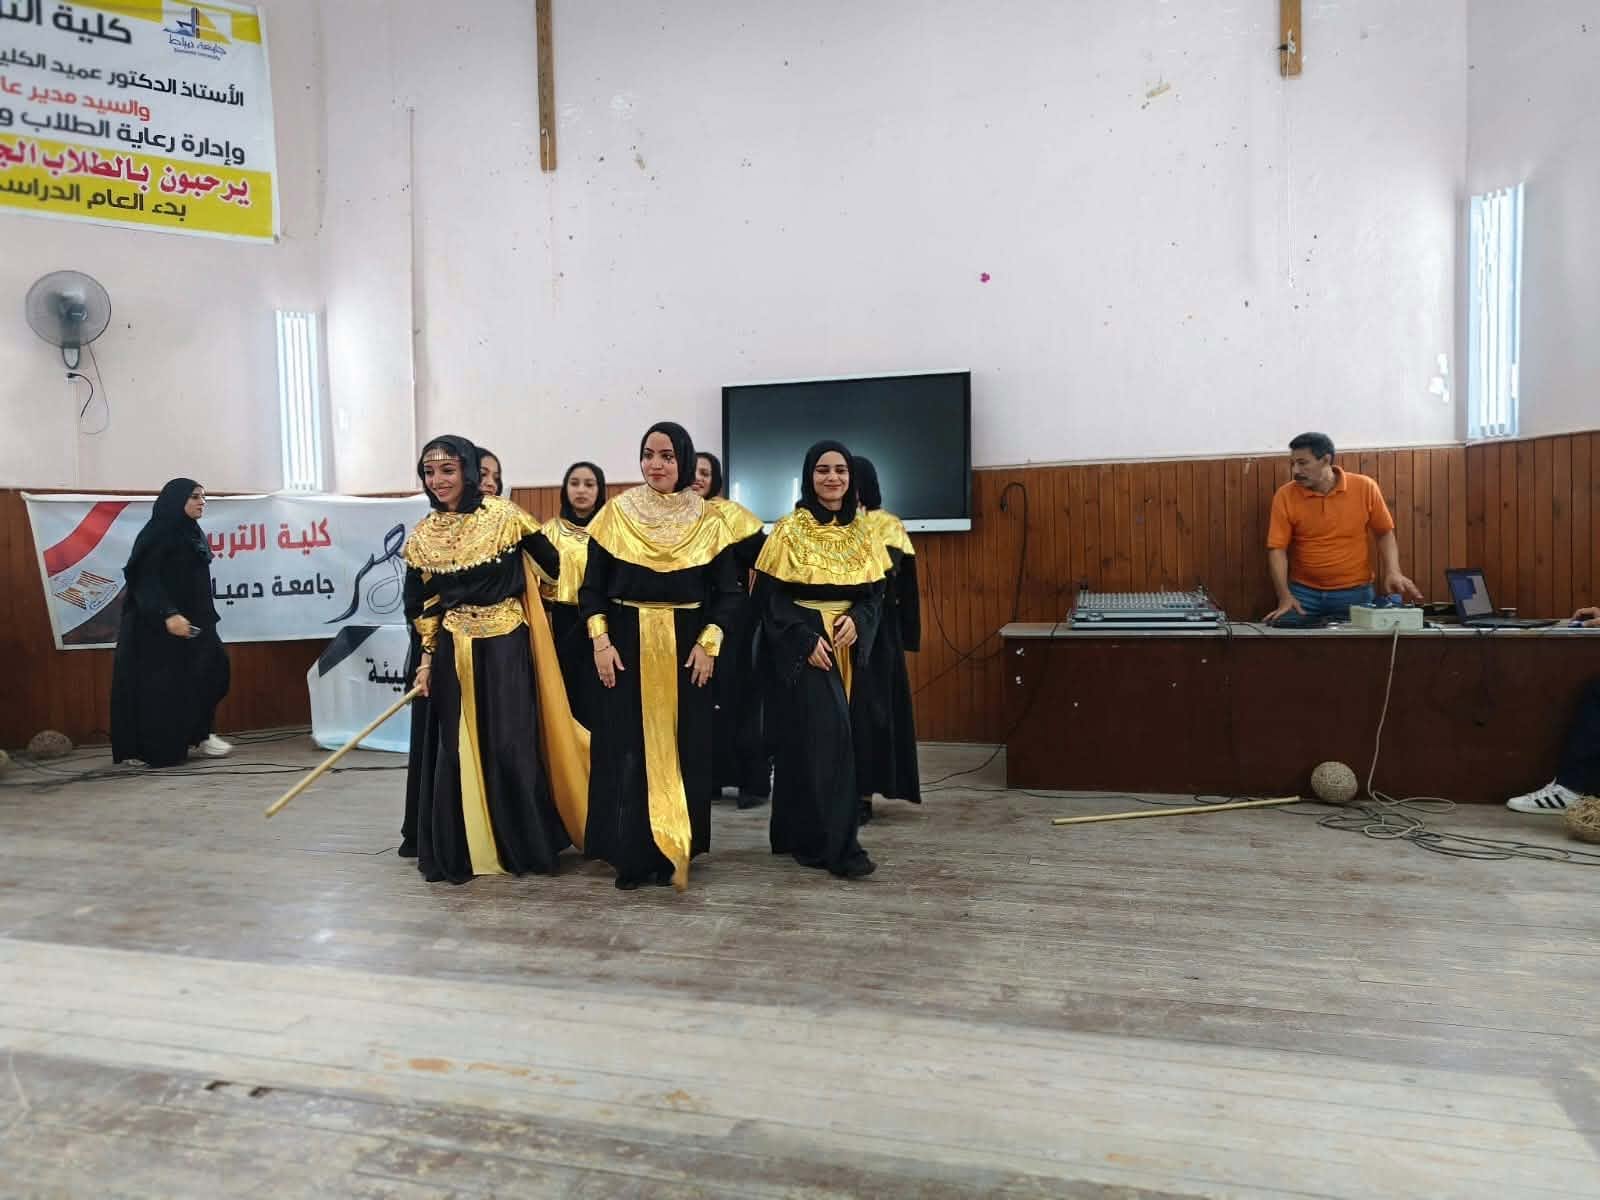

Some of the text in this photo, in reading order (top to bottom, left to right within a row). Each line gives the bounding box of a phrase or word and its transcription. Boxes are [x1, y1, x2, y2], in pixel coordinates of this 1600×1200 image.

[52, 5, 132, 44] كلية
[0, 48, 244, 107] الأستاذ الدكتور عميد الكلي
[0, 75, 151, 122] والسيد مدير عا
[21, 112, 110, 138] الطلاب
[116, 122, 176, 150] رعاية
[180, 134, 245, 165] وإدارة
[0, 141, 250, 205] يرحبون بالطلاب الج
[0, 178, 187, 221] بدء العام الدراس
[207, 517, 332, 559] كلية التربي
[211, 572, 335, 605] جامعة دميا
[365, 657, 405, 692] يئة
